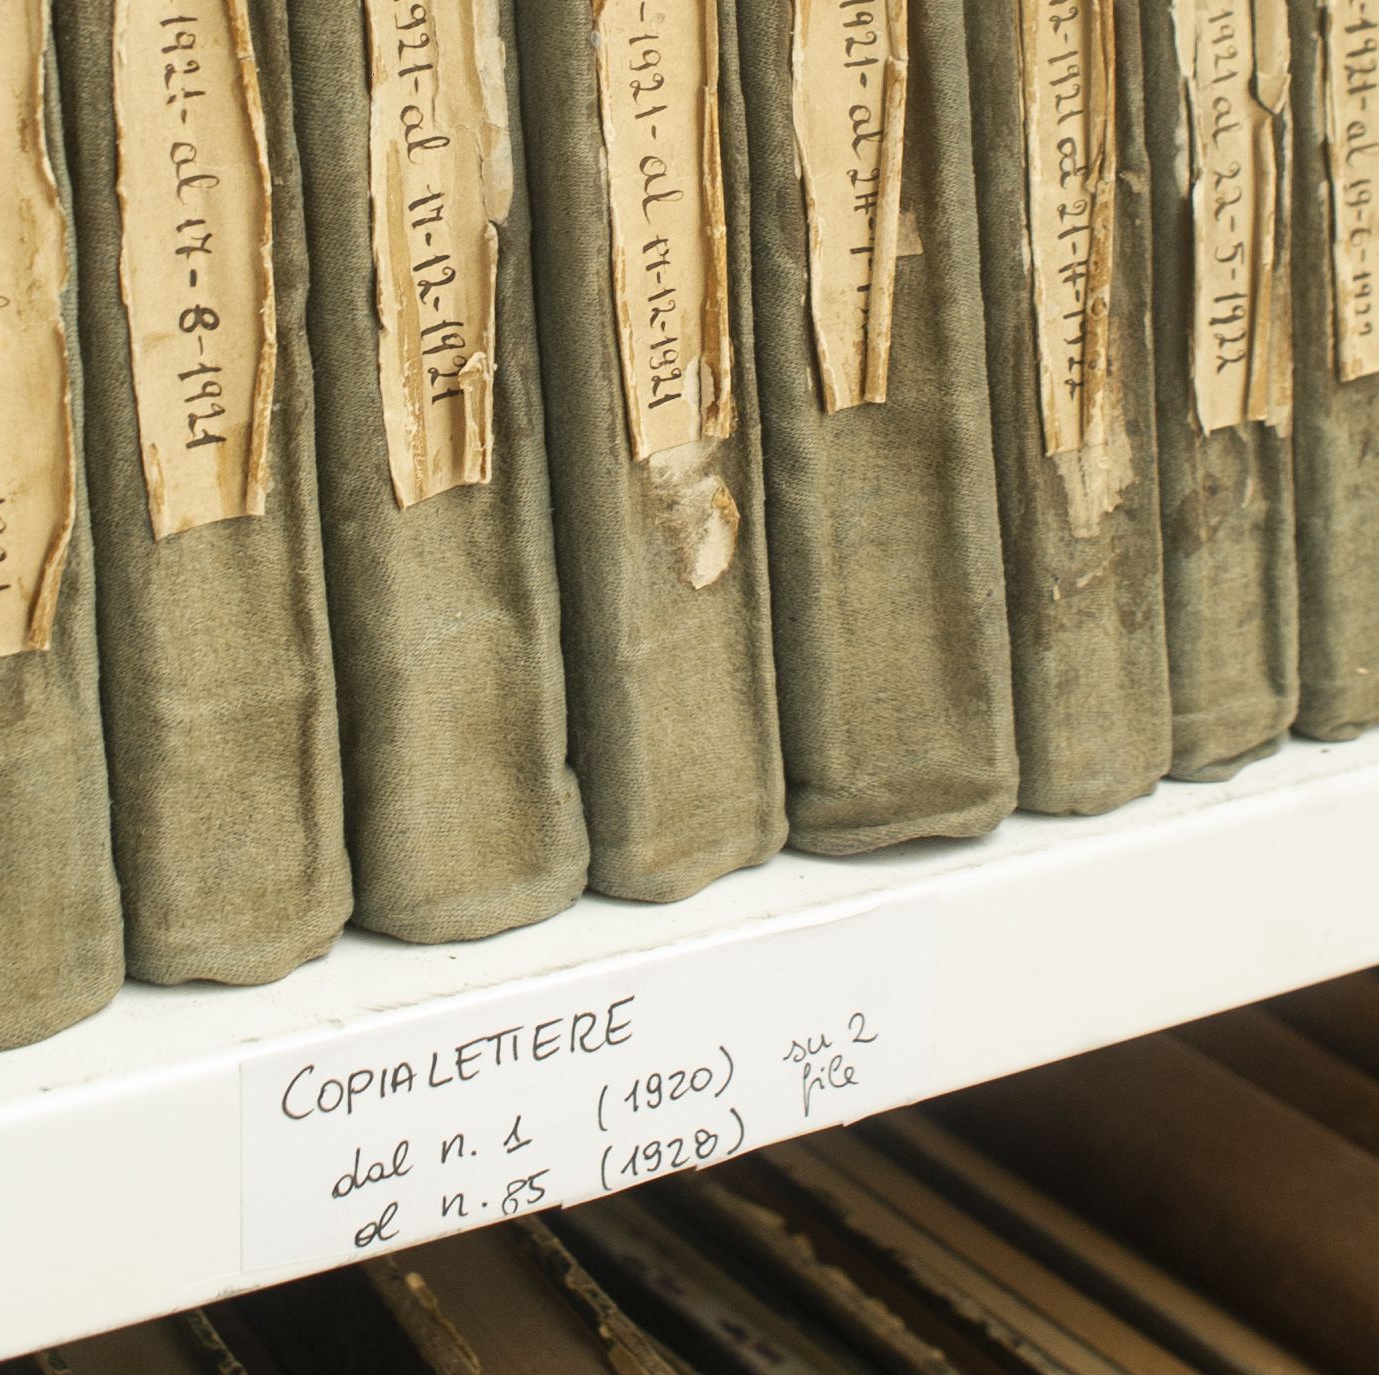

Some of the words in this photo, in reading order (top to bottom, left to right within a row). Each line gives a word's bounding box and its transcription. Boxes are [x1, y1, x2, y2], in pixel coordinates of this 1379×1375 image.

[397, 104, 449, 168] al
[850, 104, 884, 164] al
[1211, 97, 1242, 146] al
[169, 142, 219, 208] al
[638, 155, 683, 225] al
[1057, 136, 1091, 189] al
[408, 191, 467, 406] 17-12-1921
[1208, 162, 1248, 375] 22-5-1922
[174, 219, 227, 452] 17-8-1921
[642, 234, 684, 410] 17-12-1921
[331, 1139, 414, 1199] dal
[440, 1133, 478, 1164] n.
[502, 1114, 533, 1154] 1
[597, 1045, 734, 1132] (1920)
[782, 1033, 833, 1063] su
[847, 1011, 879, 1043] 2
[802, 1054, 860, 1118] file
[501, 1168, 551, 1216] 85
[601, 1107, 745, 1191] (1928)
